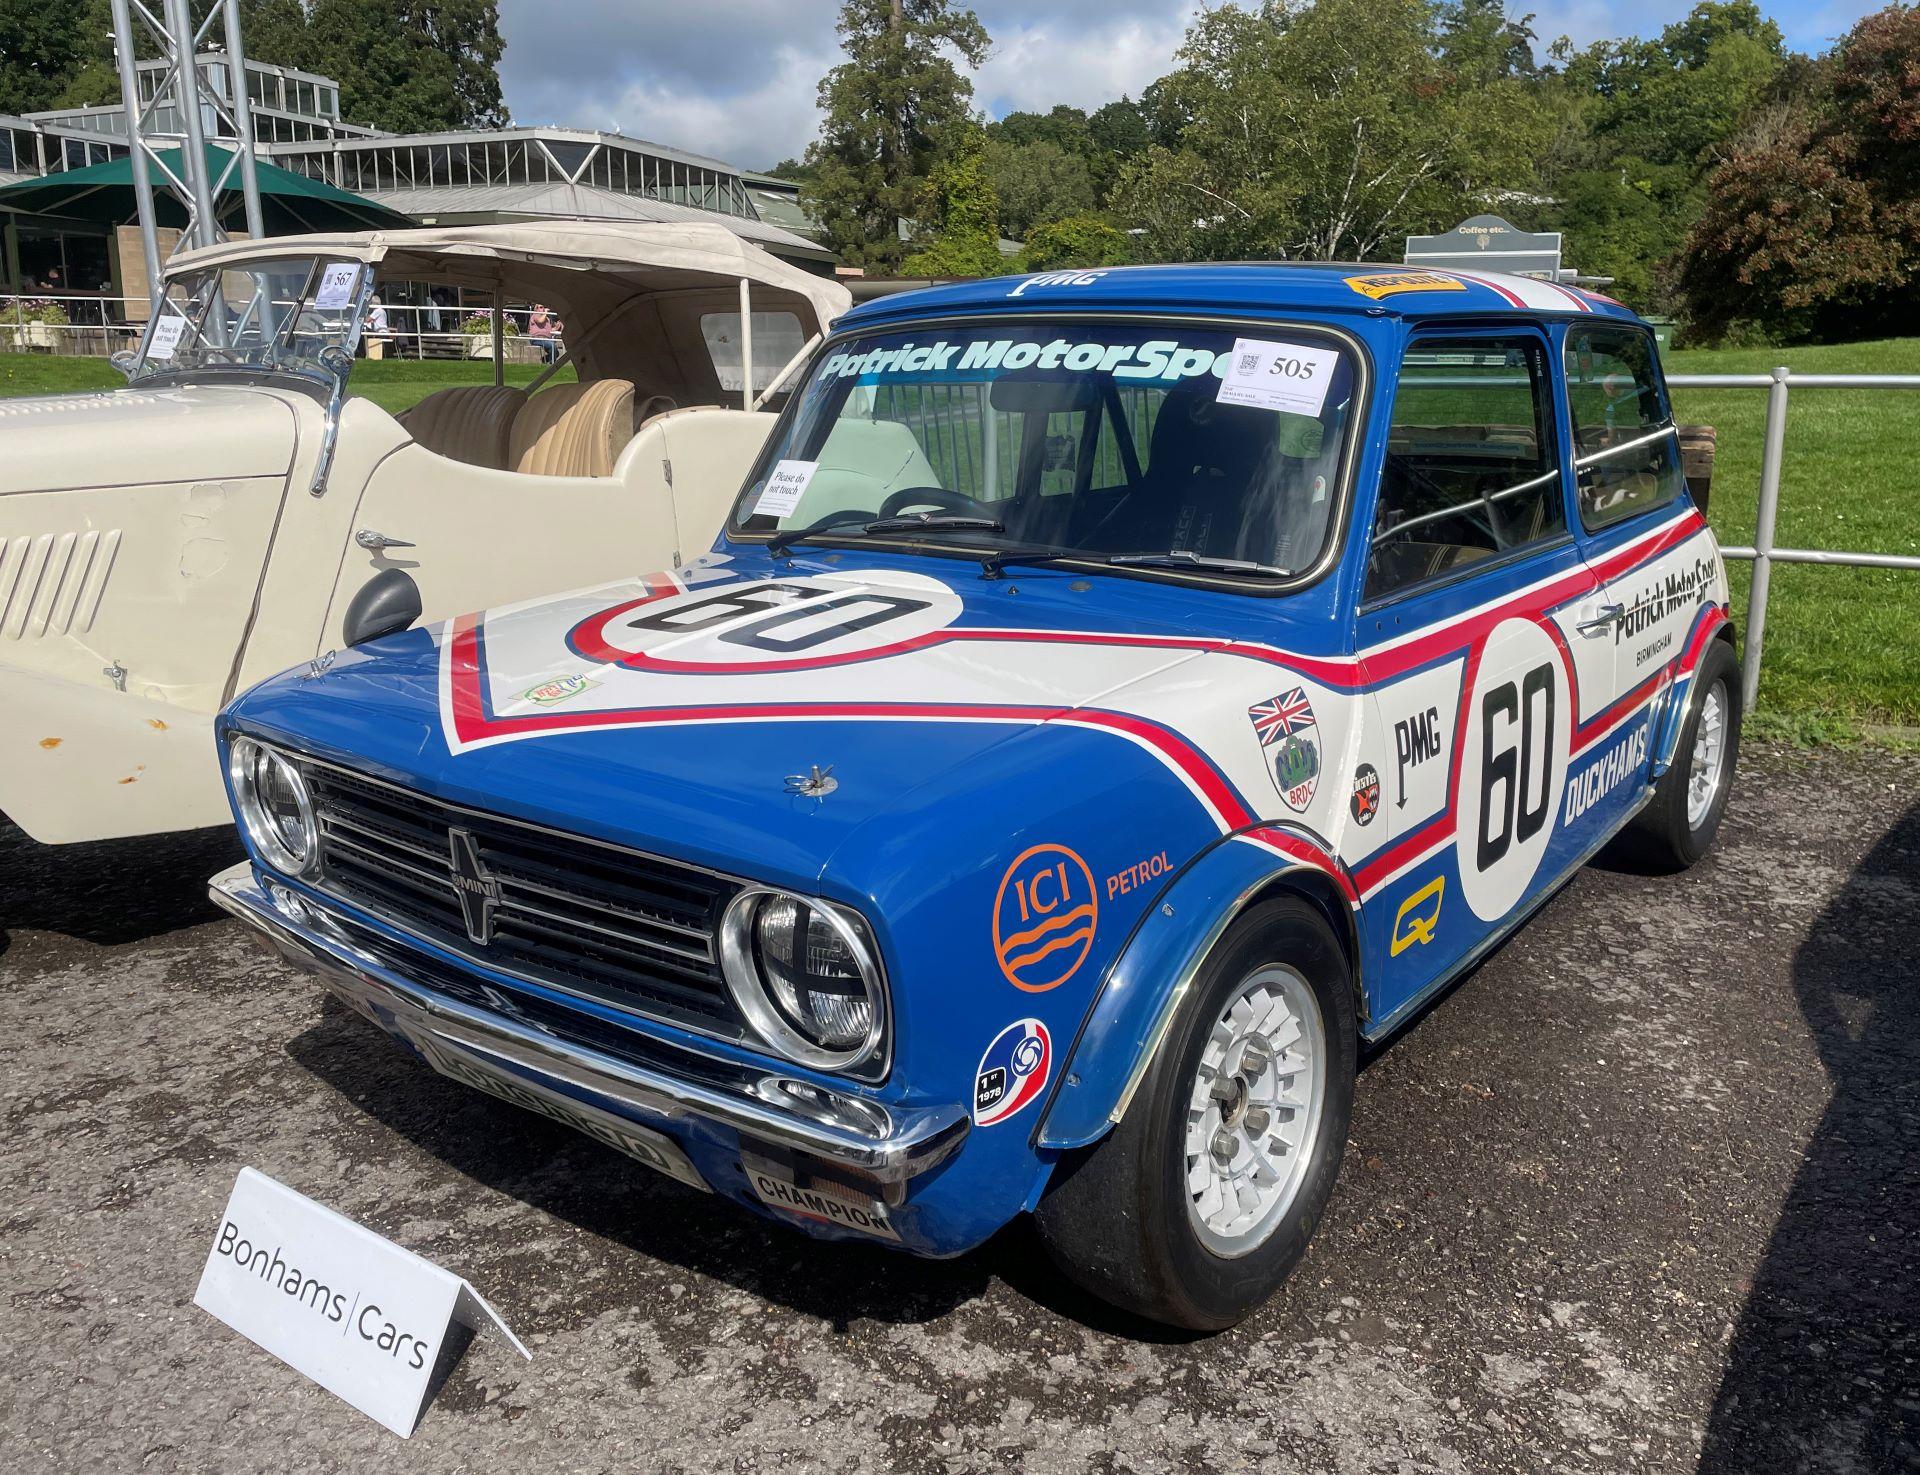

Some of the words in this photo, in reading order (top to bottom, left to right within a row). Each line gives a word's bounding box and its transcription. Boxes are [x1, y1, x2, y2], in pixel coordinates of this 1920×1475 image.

[1459, 226, 1488, 234] Coffee
[335, 272, 352, 286] 567
[1006, 272, 1109, 297] PMG
[818, 341, 961, 381] Patrick
[1269, 356, 1317, 380] 505
[769, 486, 780, 494] not
[779, 485, 799, 496] touch
[775, 471, 795, 483] Please
[795, 473, 805, 484] do
[626, 583, 933, 652] 60
[1615, 581, 1665, 647] Patrick
[1636, 631, 1673, 668] BIRMINGHAM
[1394, 706, 1441, 800] PMG
[1477, 661, 1555, 873] 60
[1289, 780, 1313, 806] BRDC
[1564, 722, 1648, 828] DUCKHAMS
[459, 875, 497, 898] MINI
[1015, 861, 1071, 923] ICI
[1106, 850, 1174, 901] PETROL
[422, 1037, 673, 1171] Longman
[978, 1086, 1002, 1103] 1978
[757, 1176, 890, 1232] CHAMPION
[217, 1221, 347, 1322] Bonhams
[358, 1304, 428, 1370] Cars
